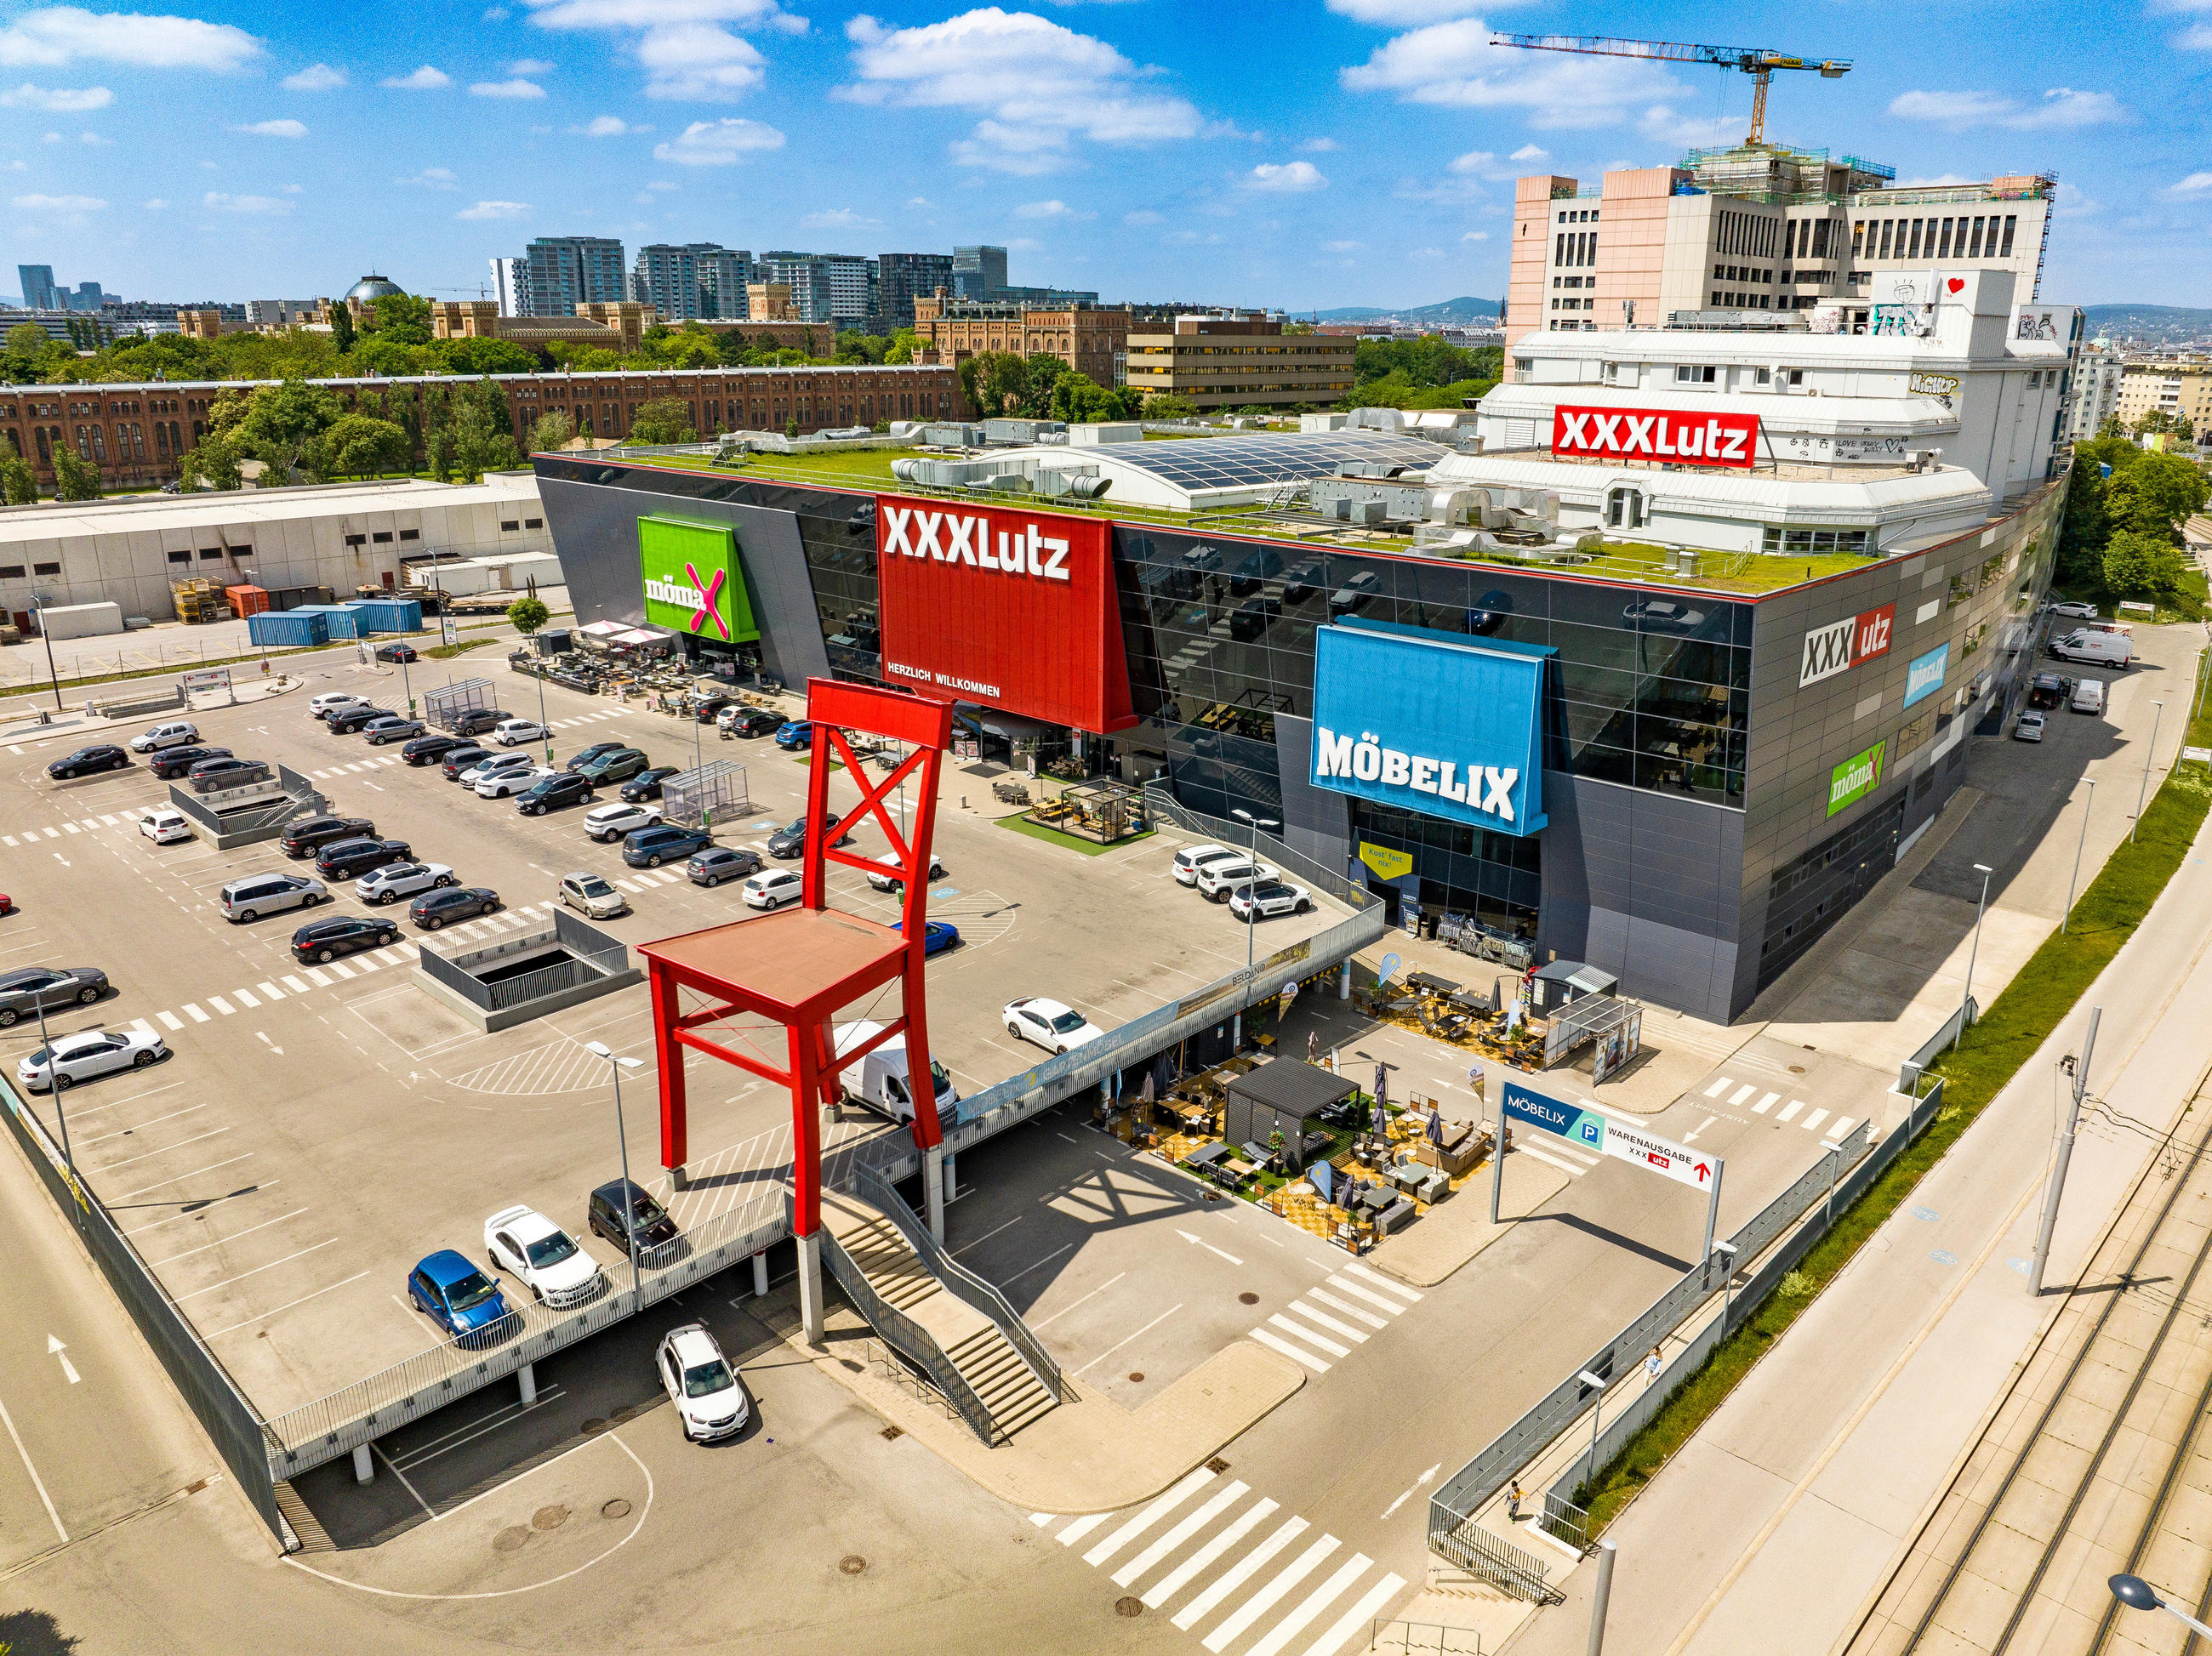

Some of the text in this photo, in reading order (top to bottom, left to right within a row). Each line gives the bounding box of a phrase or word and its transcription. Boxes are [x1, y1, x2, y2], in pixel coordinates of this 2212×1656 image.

[1559, 413, 1749, 460] XXXLutz
[883, 506, 1069, 580] XXXLutz
[1803, 613, 1890, 680] XXXLutz
[887, 662, 1001, 697] HERZLICH WILLKOMMEN
[1316, 726, 1519, 822] MÖBELIX
[1388, 853, 1402, 863] fast
[1508, 1095, 1566, 1126] MÖBELIX
[1608, 1126, 1692, 1164] WARENAUSGABE
